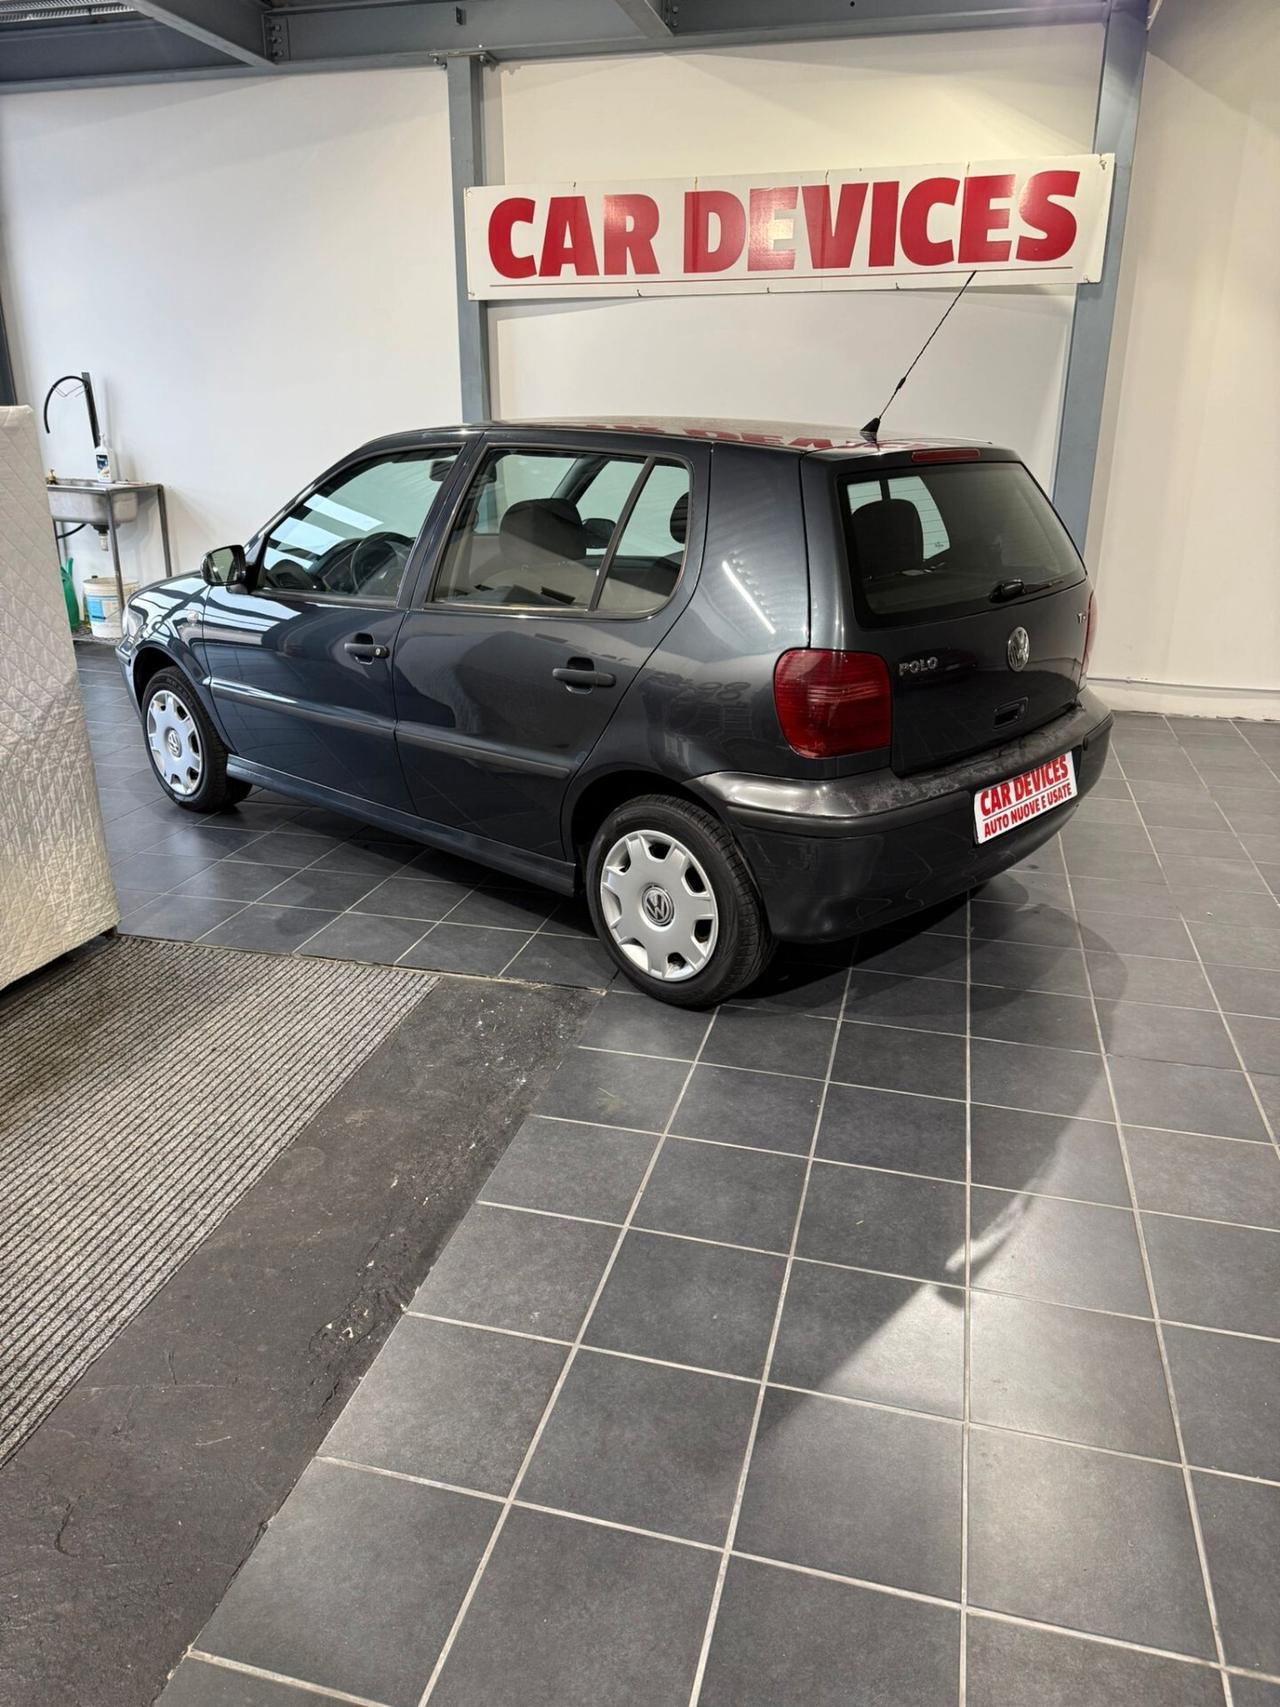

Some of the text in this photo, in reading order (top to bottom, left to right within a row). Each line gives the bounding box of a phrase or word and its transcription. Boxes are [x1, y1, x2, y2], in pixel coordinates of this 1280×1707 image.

[488, 170, 1079, 279] CAR DEVICES
[899, 656, 938, 677] POLO
[980, 754, 1069, 817] CAR DEVICES
[984, 782, 1072, 838] AUTO NUOVE E USATE
[645, 889, 672, 925] VW
